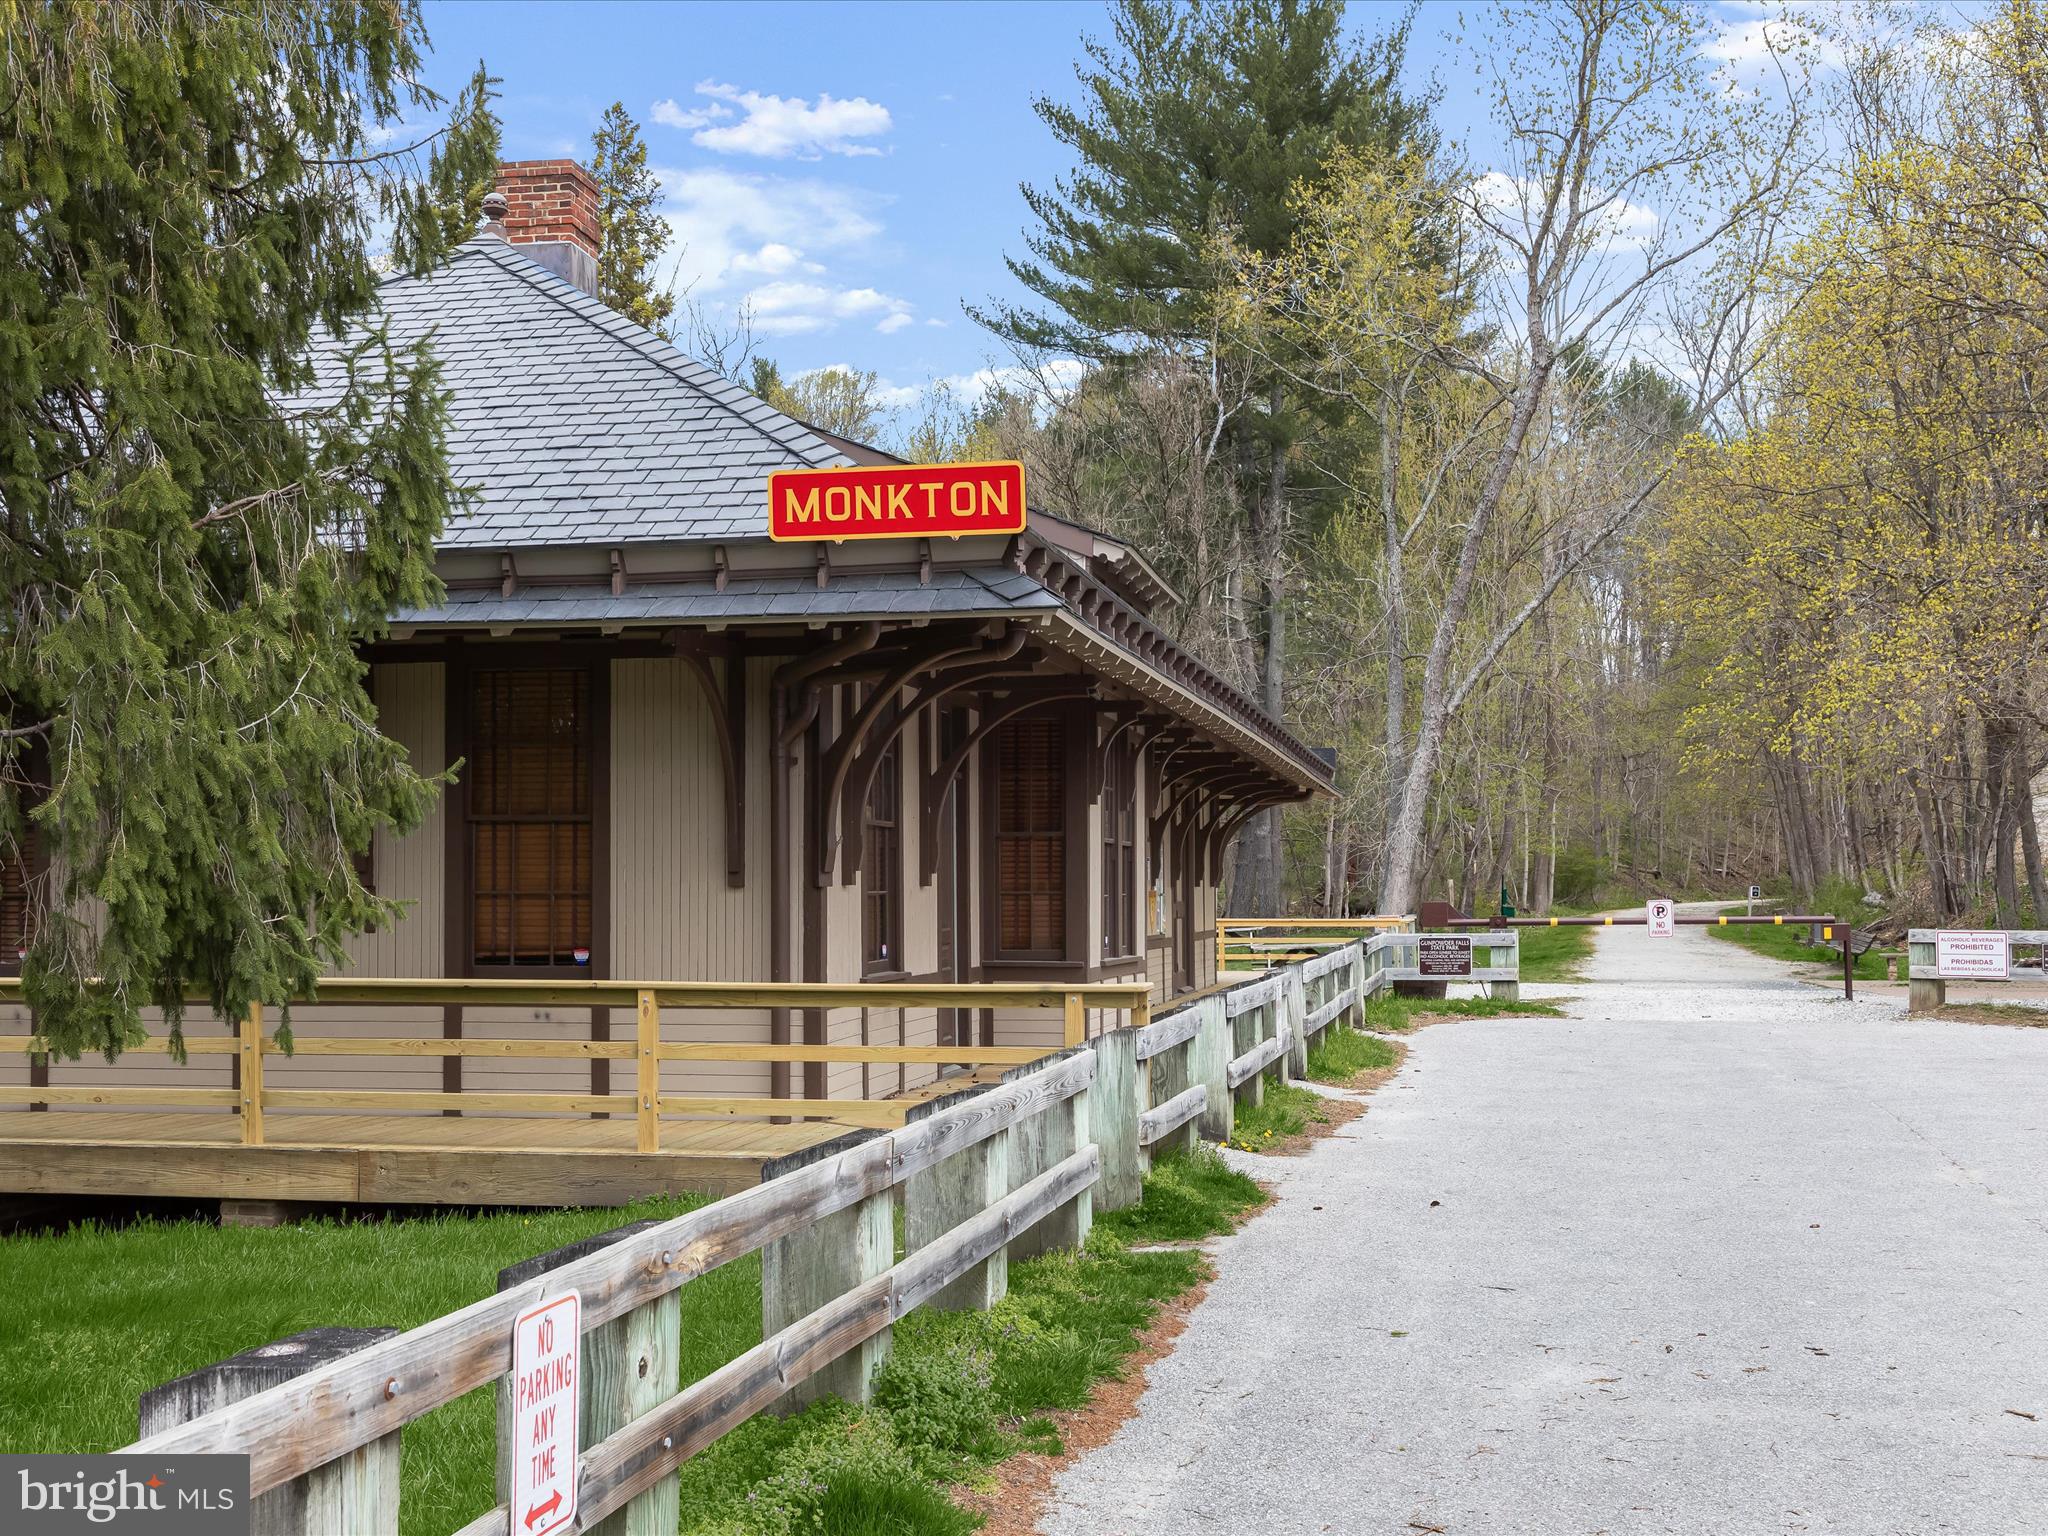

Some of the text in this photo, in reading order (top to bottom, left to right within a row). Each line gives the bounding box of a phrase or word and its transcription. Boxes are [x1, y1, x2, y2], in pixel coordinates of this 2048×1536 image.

[784, 479, 1010, 524] MONKTON
[537, 1317, 554, 1358] NO
[519, 1352, 572, 1412] PARKING
[532, 1404, 556, 1448] ANY
[531, 1445, 556, 1489] TIME
